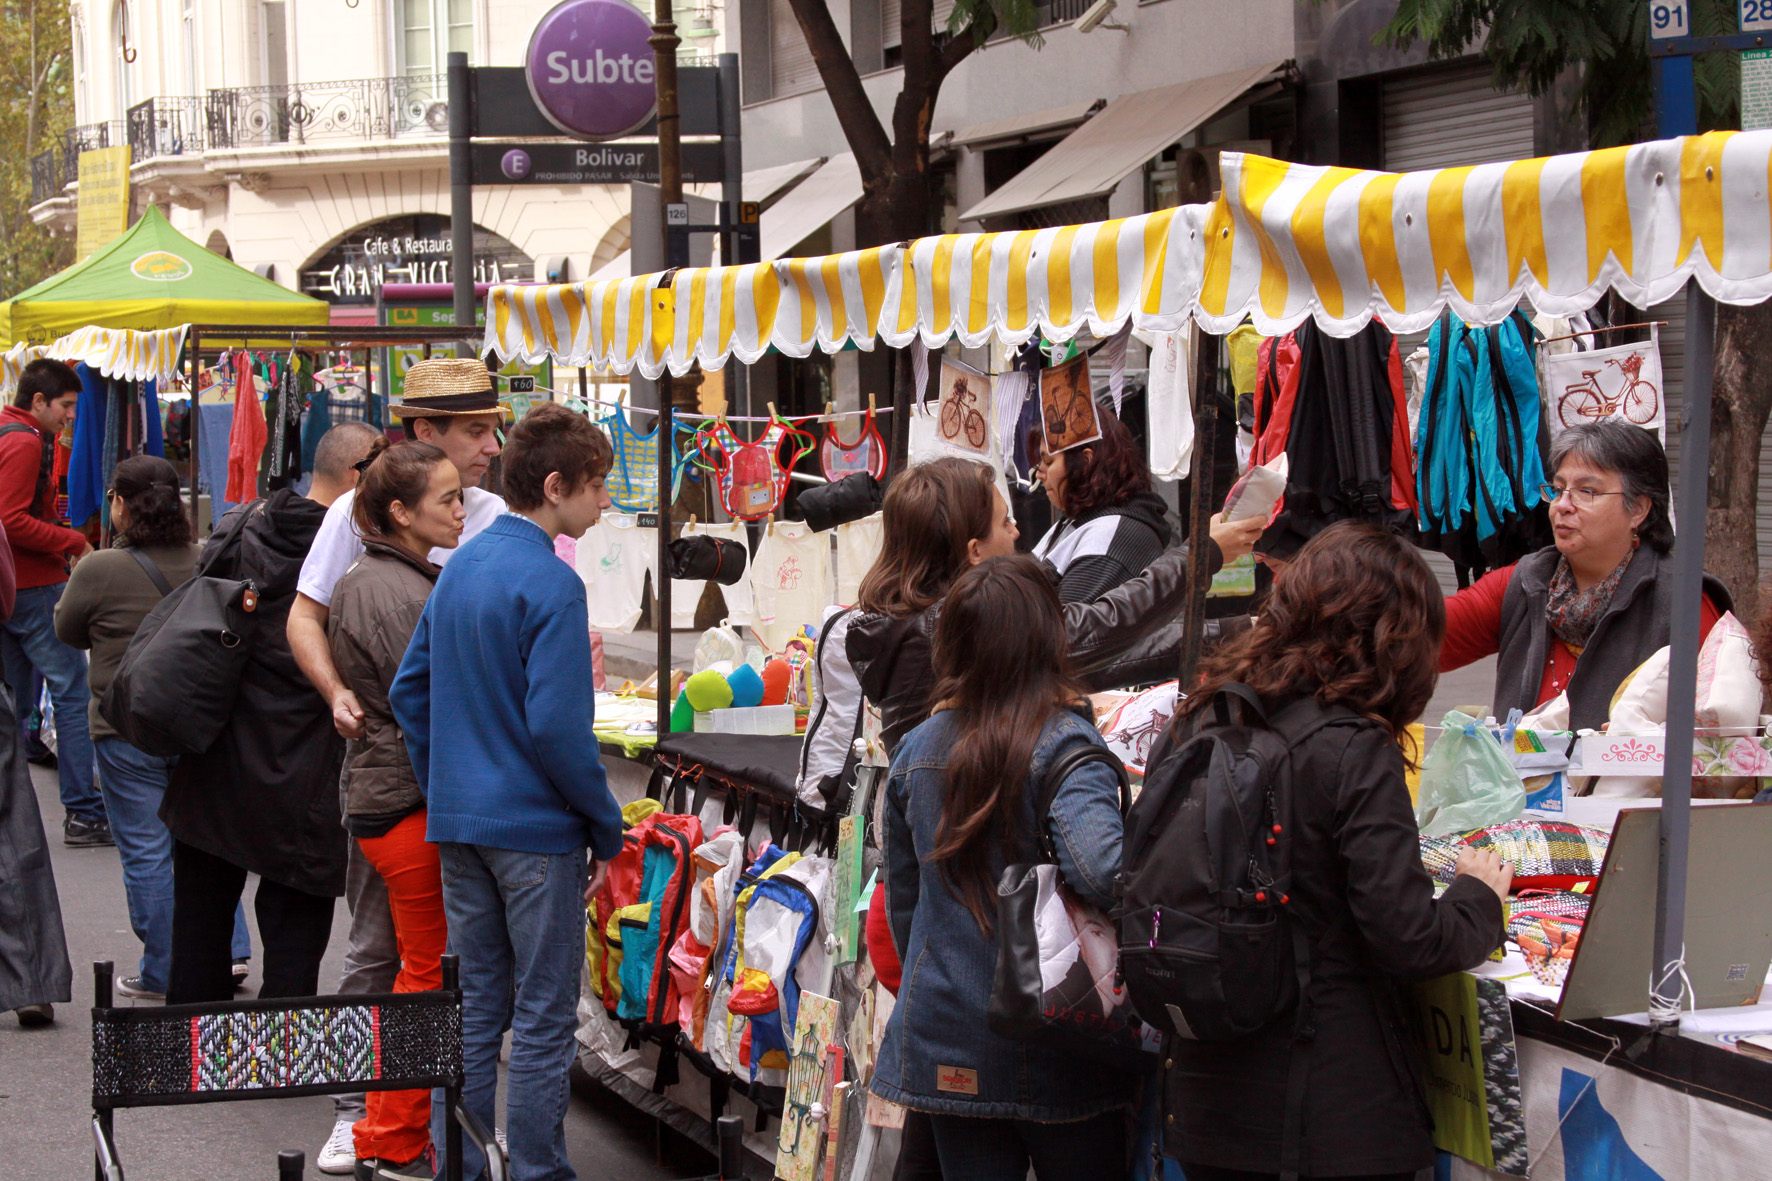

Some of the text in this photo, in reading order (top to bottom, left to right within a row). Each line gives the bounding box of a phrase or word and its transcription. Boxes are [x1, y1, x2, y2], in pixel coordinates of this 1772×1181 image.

[1653, 5, 1683, 29] 91
[1743, 0, 1772, 23] 28
[546, 49, 654, 85] Subte
[511, 155, 524, 174] E
[576, 148, 645, 167] Bolivar
[535, 172, 583, 180] PROHIBIDO
[584, 172, 612, 180] PASAR
[667, 208, 686, 220] 126
[744, 204, 756, 221] P
[364, 236, 453, 255] Cafe & Restaura
